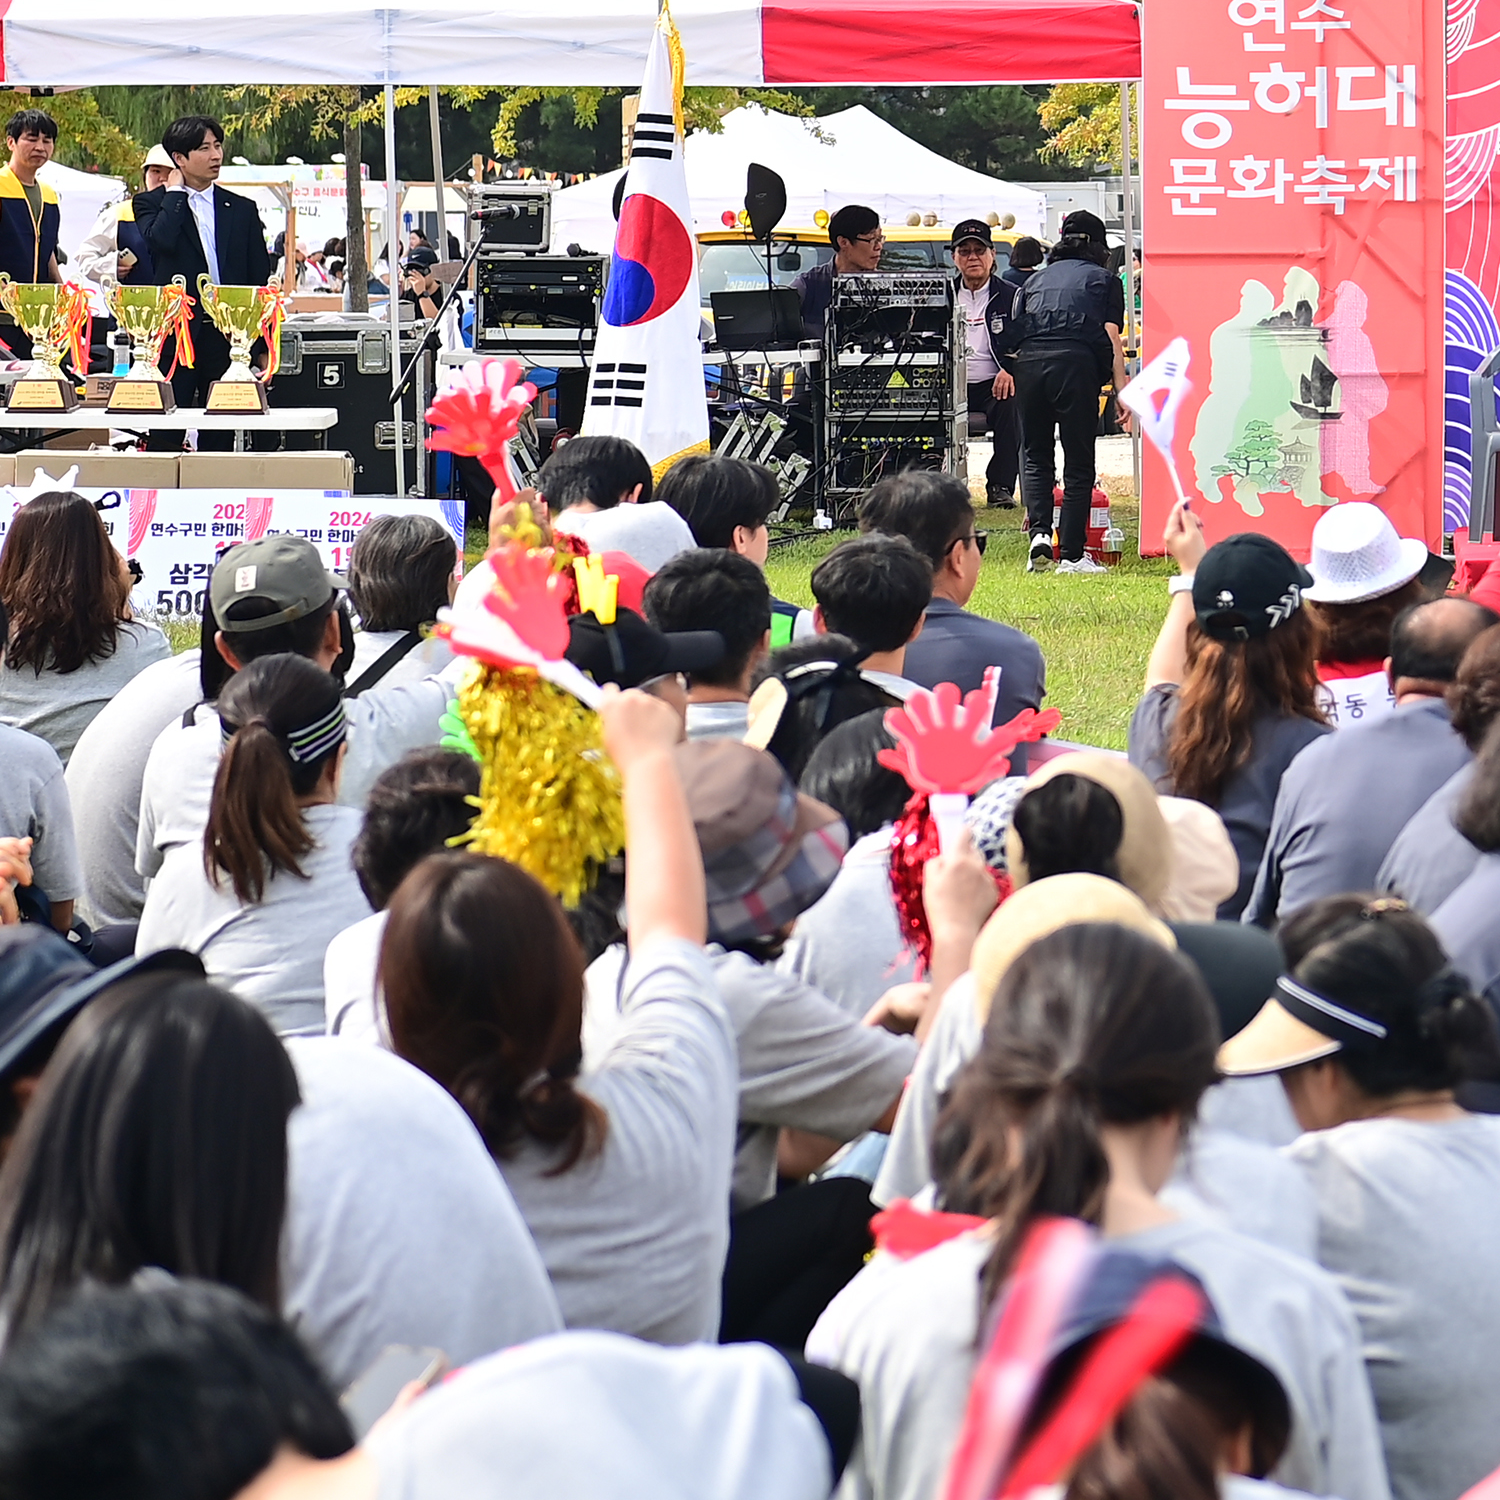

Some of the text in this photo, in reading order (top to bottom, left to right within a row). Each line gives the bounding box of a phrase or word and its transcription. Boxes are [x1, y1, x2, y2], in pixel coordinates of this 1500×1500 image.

[1164, 62, 1416, 149] 능허대
[1164, 155, 1417, 216] 문화축제
[323, 365, 340, 386] 5
[213, 503, 245, 520] 202
[151, 523, 206, 537] 연수구민
[327, 529, 361, 543] 한마
